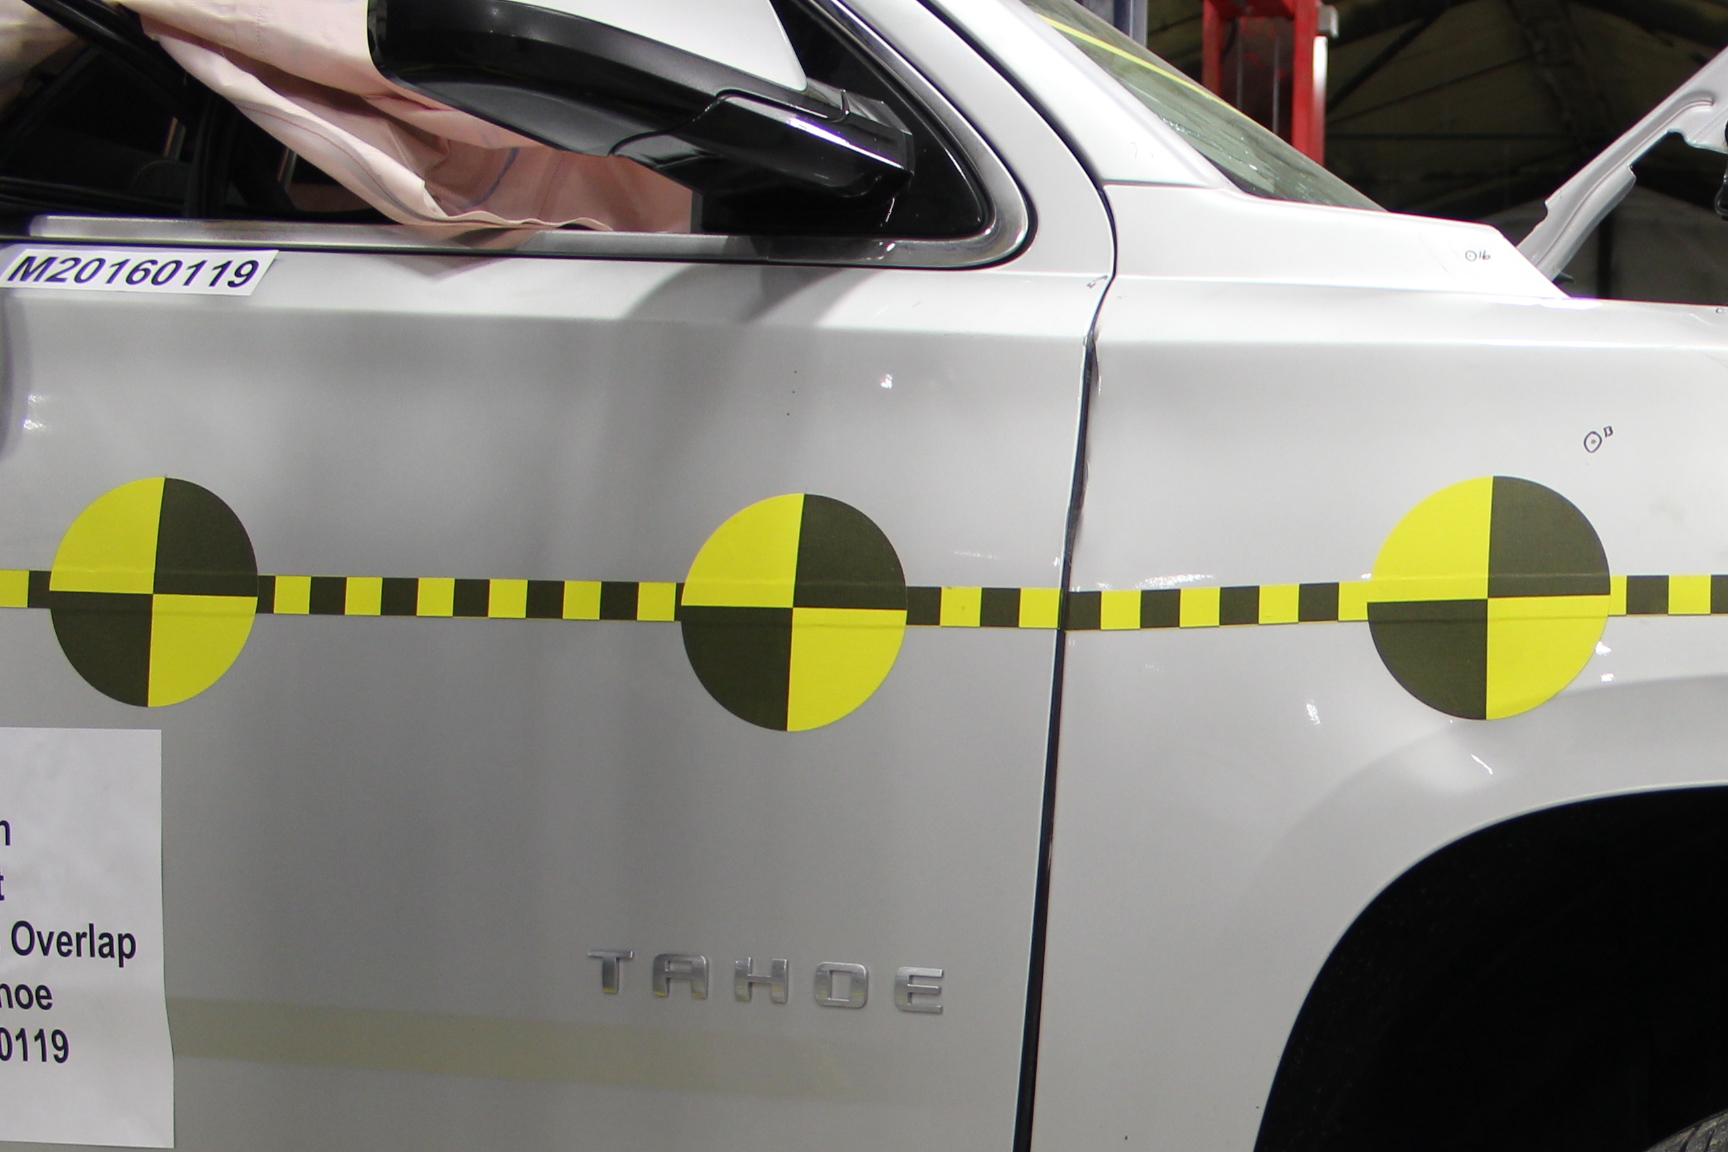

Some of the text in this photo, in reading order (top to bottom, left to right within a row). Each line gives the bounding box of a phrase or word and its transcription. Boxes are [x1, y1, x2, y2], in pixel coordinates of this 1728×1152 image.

[7, 256, 260, 288] M20160119
[11, 920, 137, 968] Overlap
[588, 949, 945, 1014] TAHOE
[0, 1027, 69, 1063] 0119
